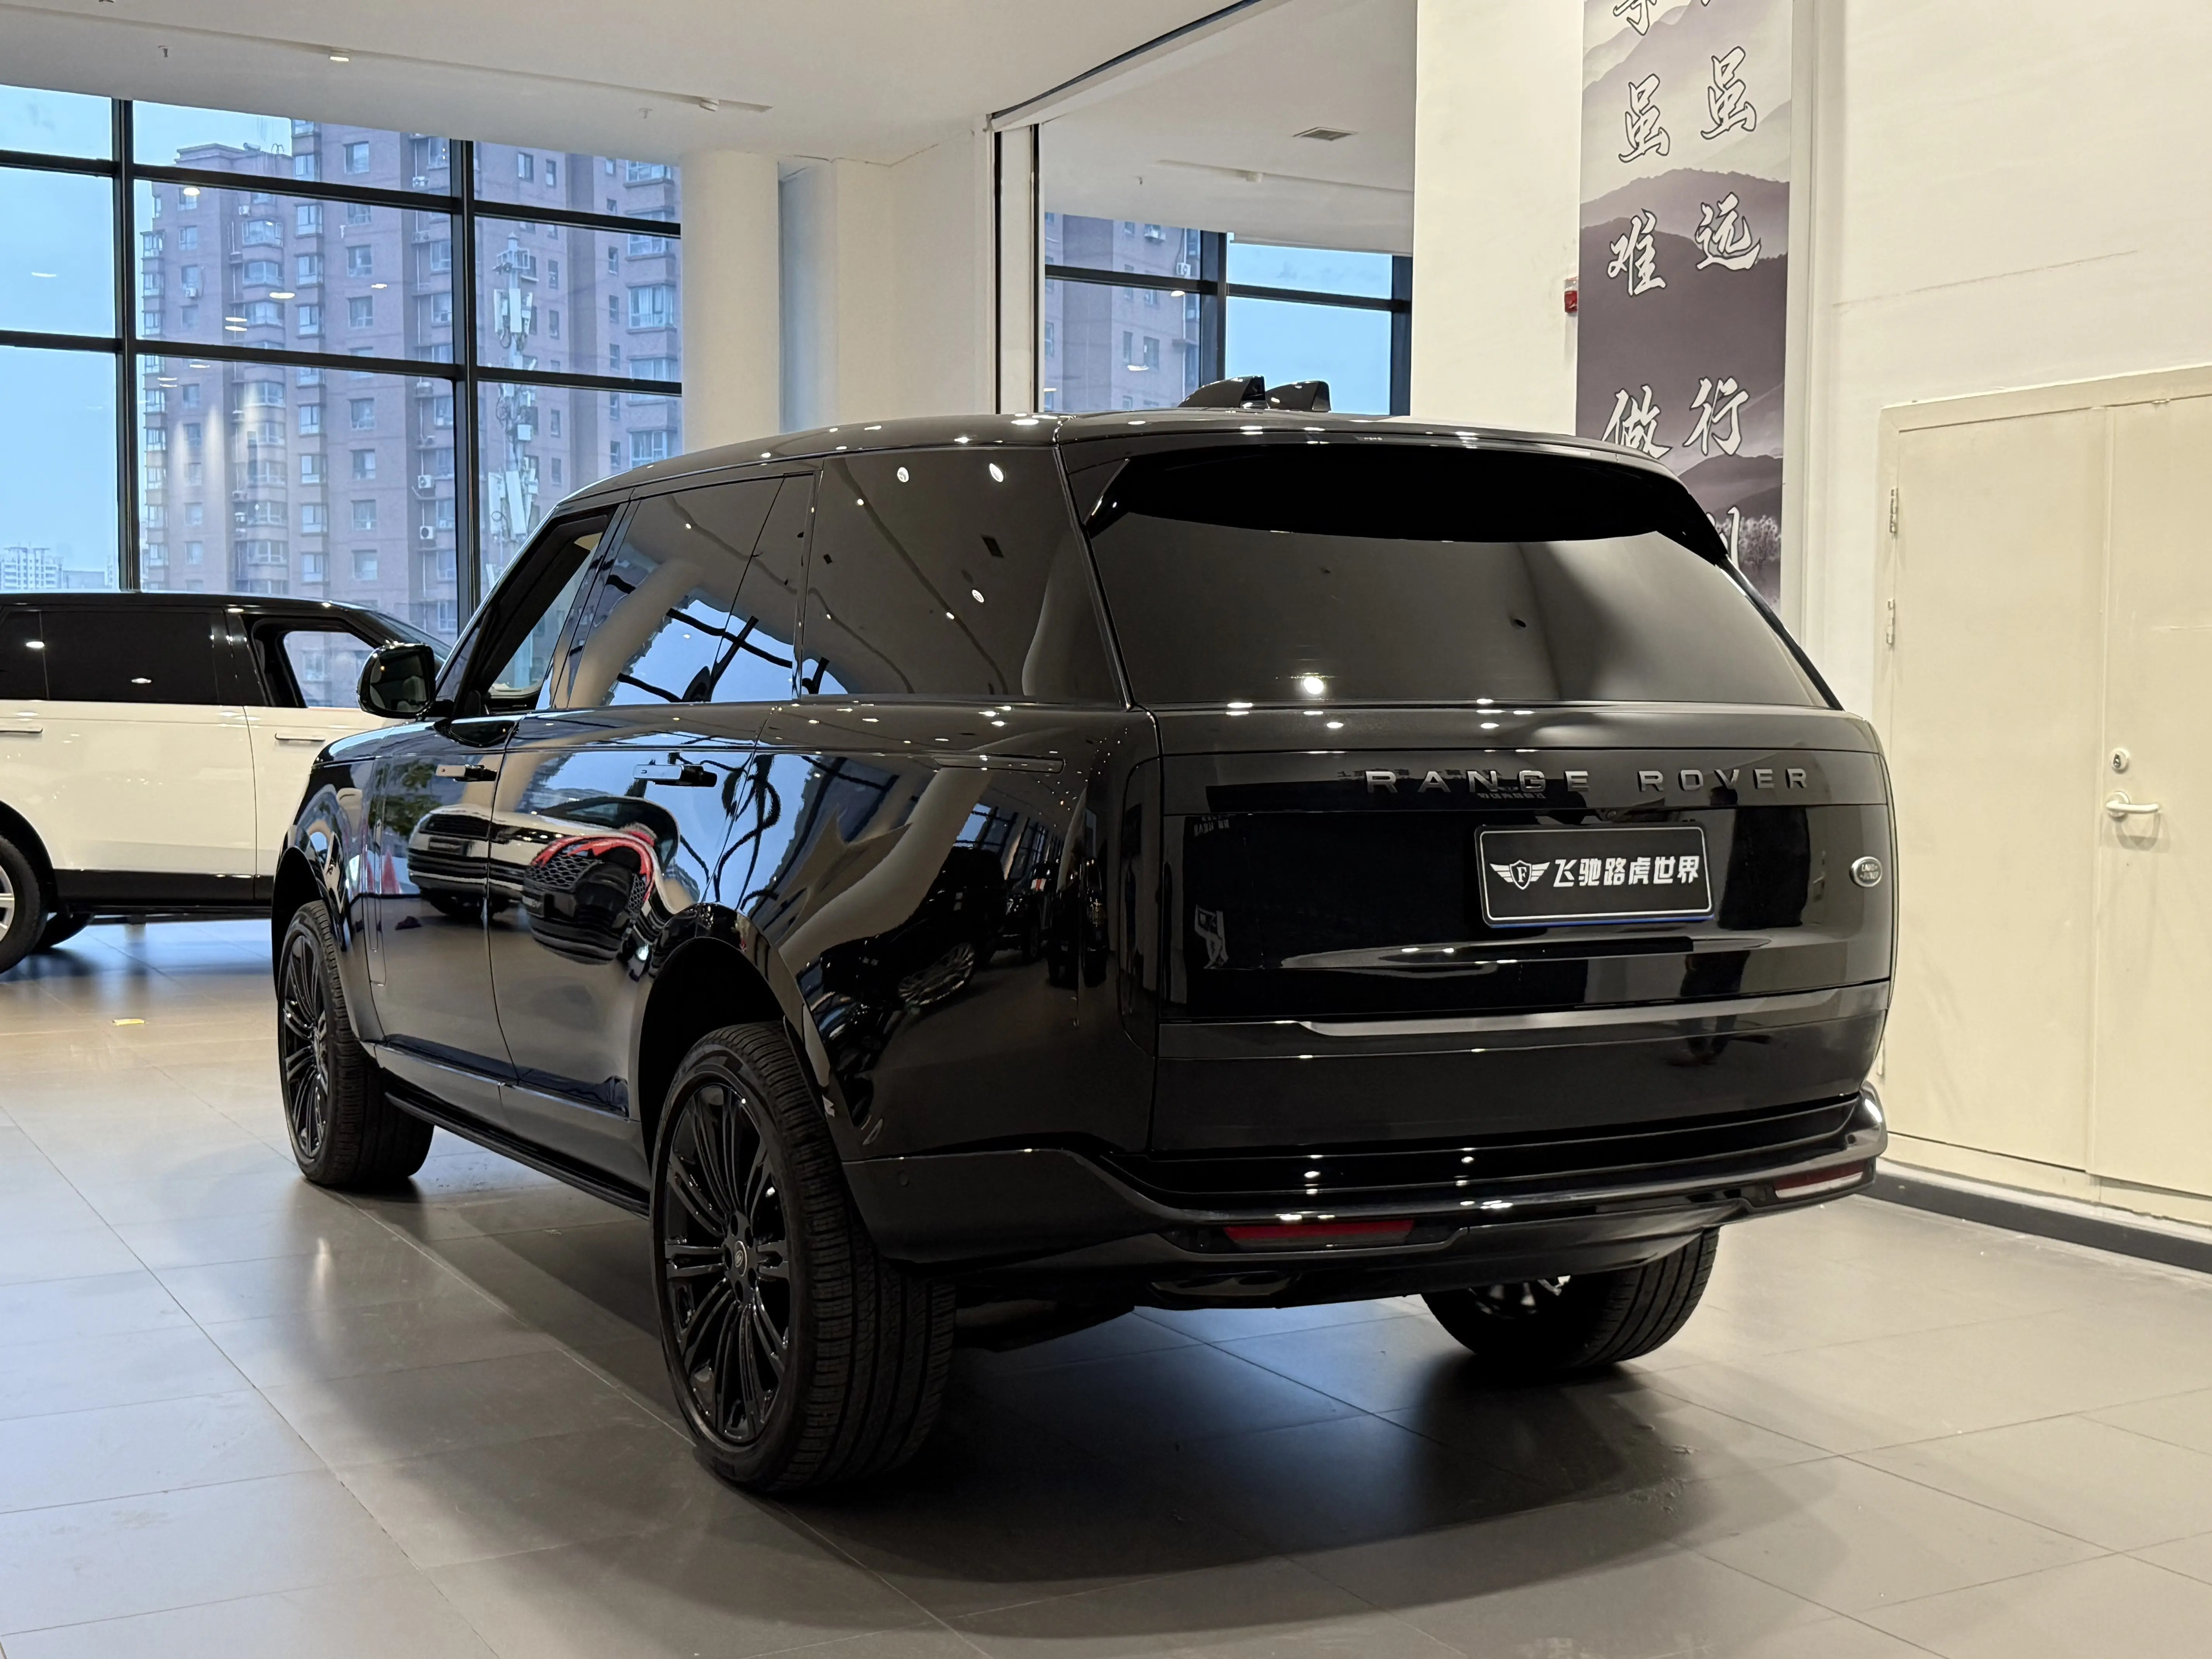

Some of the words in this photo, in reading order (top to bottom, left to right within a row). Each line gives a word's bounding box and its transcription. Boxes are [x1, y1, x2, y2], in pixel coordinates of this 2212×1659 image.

[1365, 770, 1589, 793] RANGE
[1638, 768, 1807, 792] ROVER
[1517, 866, 1527, 883] F
[1553, 855, 1700, 887] 飞驰路虎世界
